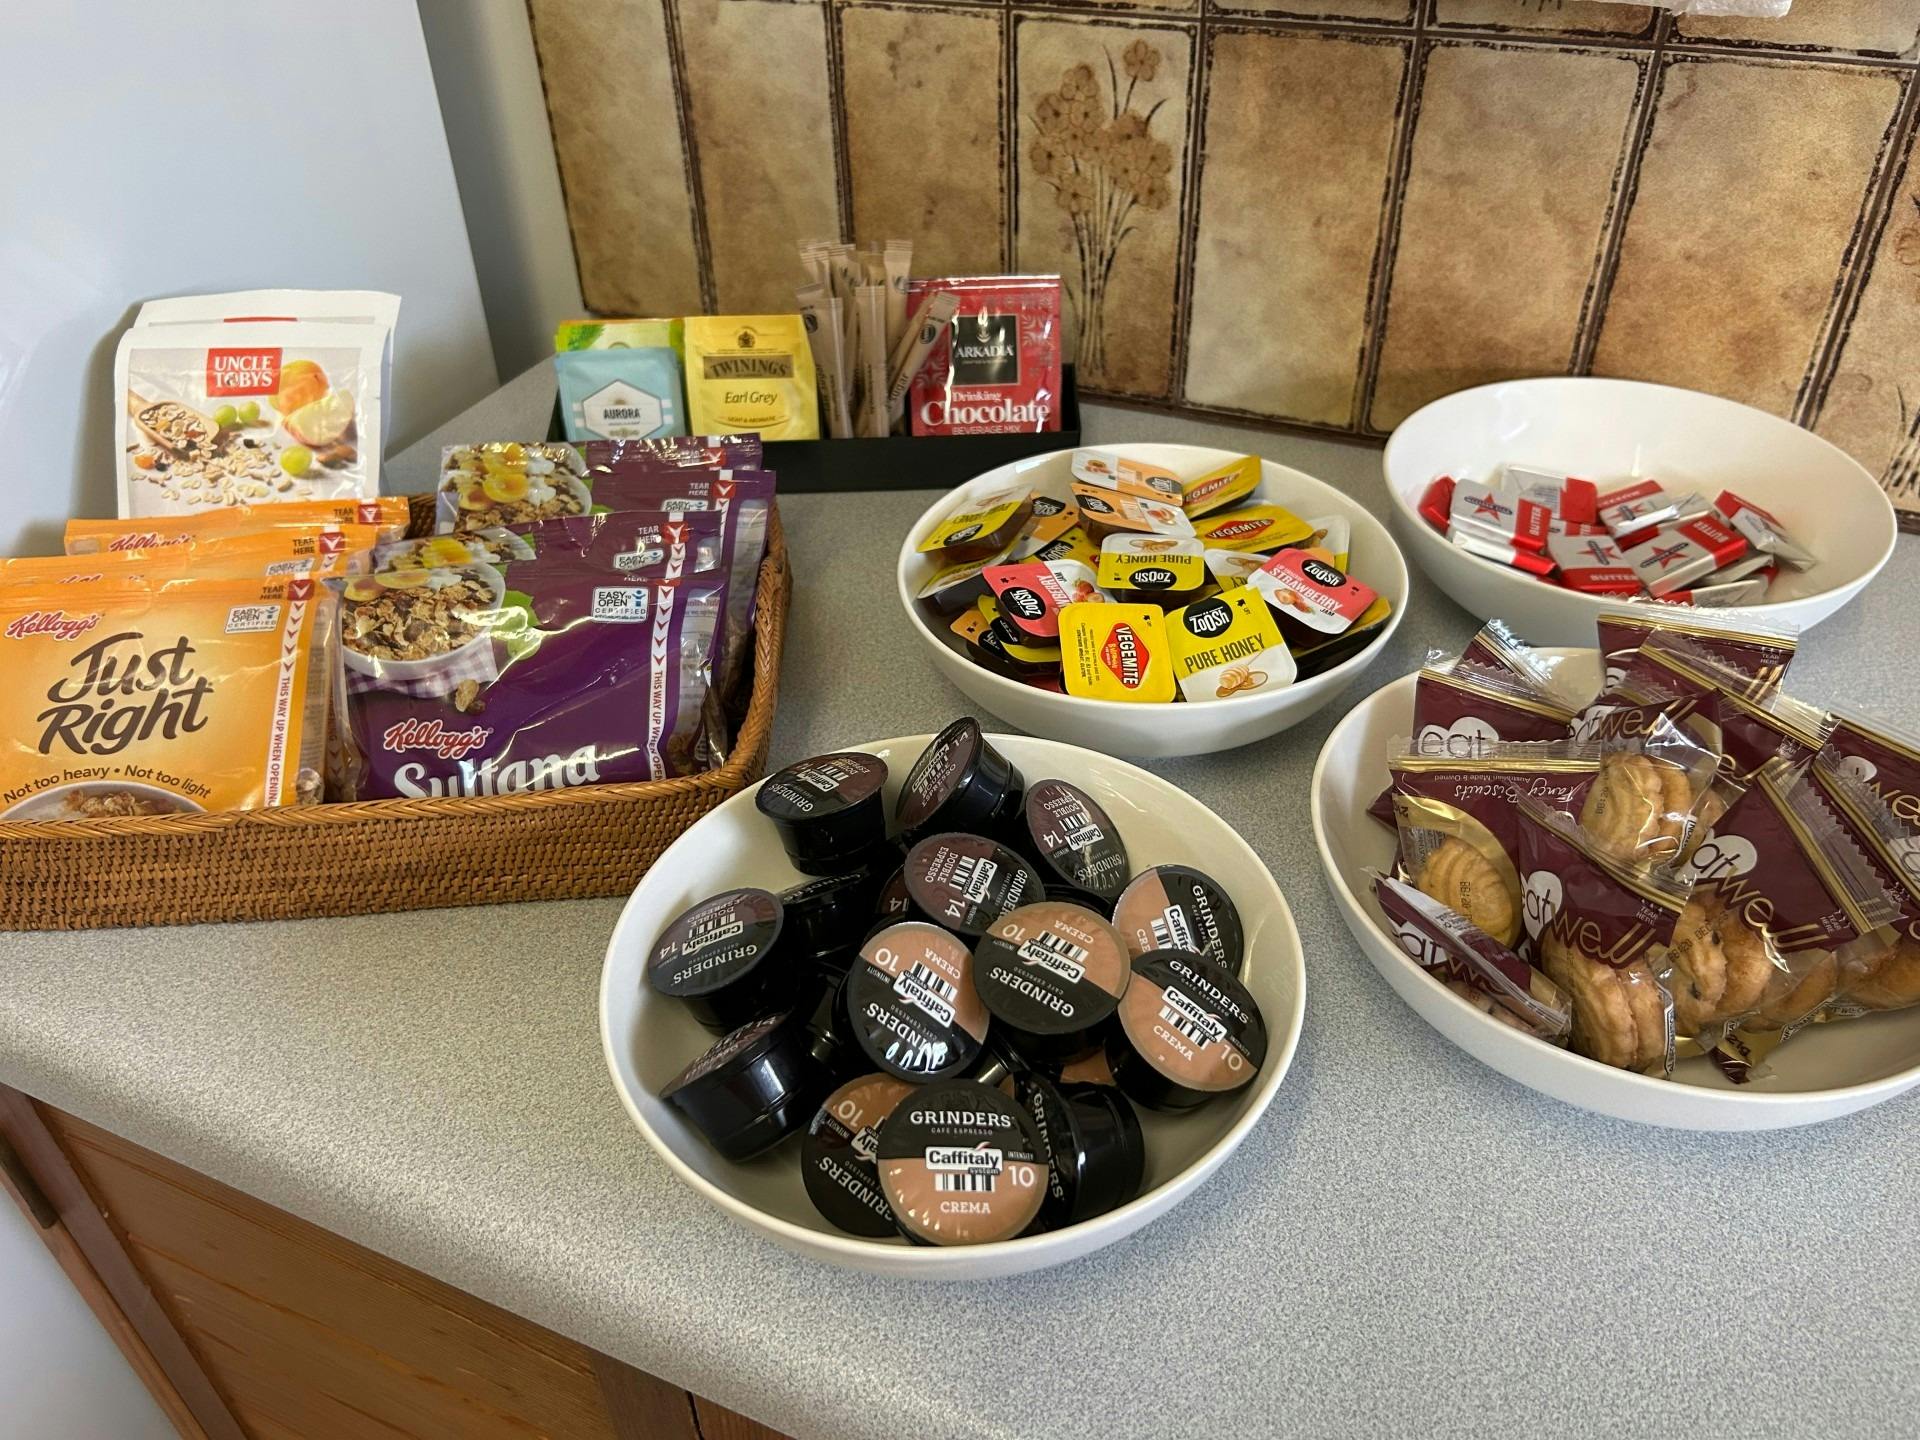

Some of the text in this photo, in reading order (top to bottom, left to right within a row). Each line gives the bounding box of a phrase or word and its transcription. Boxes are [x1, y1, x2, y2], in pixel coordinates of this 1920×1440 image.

[955, 344, 1014, 359] ARKADIA
[214, 355, 273, 372] UNCLE
[710, 358, 787, 378] TWININGS
[213, 371, 273, 388] TOBYS
[724, 391, 778, 406] Earl Grey
[951, 392, 1002, 403] Drinking
[603, 407, 641, 420] AURORA
[920, 399, 1050, 427] Chocolate
[952, 425, 1022, 435] BEVERAGE MIX
[690, 482, 710, 490] TEAR
[638, 525, 660, 535] TEAR
[1207, 519, 1272, 539] VEGEMITE
[1528, 507, 1543, 537] BUTTER
[1693, 520, 1730, 544] BUTTER
[292, 539, 315, 547] TEAR
[293, 547, 316, 555] HERE
[1116, 554, 1192, 565] PURE HONEY
[1590, 573, 1639, 582] BUTTER
[598, 591, 627, 600] EASY
[1269, 566, 1344, 612] STRAWBERRY
[598, 599, 628, 607] OPEN
[1319, 607, 1336, 617] JAM
[6, 611, 101, 640] Kellogg's
[231, 615, 260, 623] OPEN
[1115, 626, 1139, 685] VEGEMITE
[1184, 632, 1266, 674] PURE HONEY
[48, 632, 196, 703] Just
[281, 677, 291, 697] THIS
[37, 676, 213, 755] Right
[279, 696, 288, 717] WAY
[649, 670, 663, 755] THIS WAY UP WHEN
[277, 718, 285, 733] UP
[272, 733, 284, 763] WHEN
[384, 719, 489, 759] Kellogg's
[1420, 728, 1490, 759] eat
[394, 744, 601, 798] Sultana
[1434, 774, 1462, 782] Owned
[1469, 774, 1494, 782] Made
[1494, 774, 1532, 783] Australian
[3, 764, 212, 804] Not too heavy Not too light
[1454, 777, 1583, 803] Fancy Biscuits
[767, 783, 814, 813] GRINDERS
[1052, 803, 1081, 818] DOUBLE
[1043, 833, 1064, 848] 14
[1069, 825, 1102, 849] Caffitaly
[924, 846, 949, 884] ESPRESSO
[937, 852, 958, 883] DOUBLE
[1078, 853, 1123, 882] GRINDERS
[969, 860, 995, 901] Caffitaly
[1690, 843, 1833, 949] at well
[691, 905, 735, 929] DOUBLE
[944, 899, 965, 919] 14
[1636, 911, 1655, 926] HERE
[1640, 906, 1659, 921] TEAR
[1002, 923, 1027, 942] 10
[1054, 919, 1095, 944] CREMA
[1169, 908, 1193, 953] Caffita
[1192, 884, 1228, 969] GRINDERS
[1820, 916, 1834, 934] HERE
[1828, 914, 1842, 931] TEAR
[684, 923, 742, 953] Caffitaly
[992, 939, 1016, 951] INTENSITY
[1551, 911, 1656, 964] well
[659, 941, 679, 960] 14
[875, 947, 900, 973] 10
[1022, 941, 1082, 981] Caffitaly
[673, 943, 758, 985] GRINDERS
[924, 947, 961, 980] CREMA
[866, 966, 891, 984] INTENSITY
[1013, 966, 1046, 985] ESPRESSO
[899, 976, 953, 1022] Caffitaly
[989, 966, 1075, 1018] GRINDERS
[1169, 960, 1249, 1024] GRINDERS
[1181, 977, 1231, 1018] CAFE ESPRESSO
[1166, 989, 1225, 1039] Caffitaly
[866, 1002, 938, 1056] INDERS
[1191, 1020, 1218, 1043] system
[1152, 1025, 1195, 1062] CREMA
[1220, 1044, 1243, 1071] 10
[837, 1099, 865, 1128] 10
[909, 1110, 1011, 1128] GRINDERS
[826, 1119, 850, 1139] INTENSITY
[930, 1127, 993, 1136] CAFE ESPRESSO
[928, 1148, 1000, 1170] Caffitaly
[1007, 1151, 1035, 1161] INTENSITY
[968, 1166, 1001, 1175] system
[1007, 1166, 1036, 1189] 10
[940, 1200, 991, 1215] CREMA
